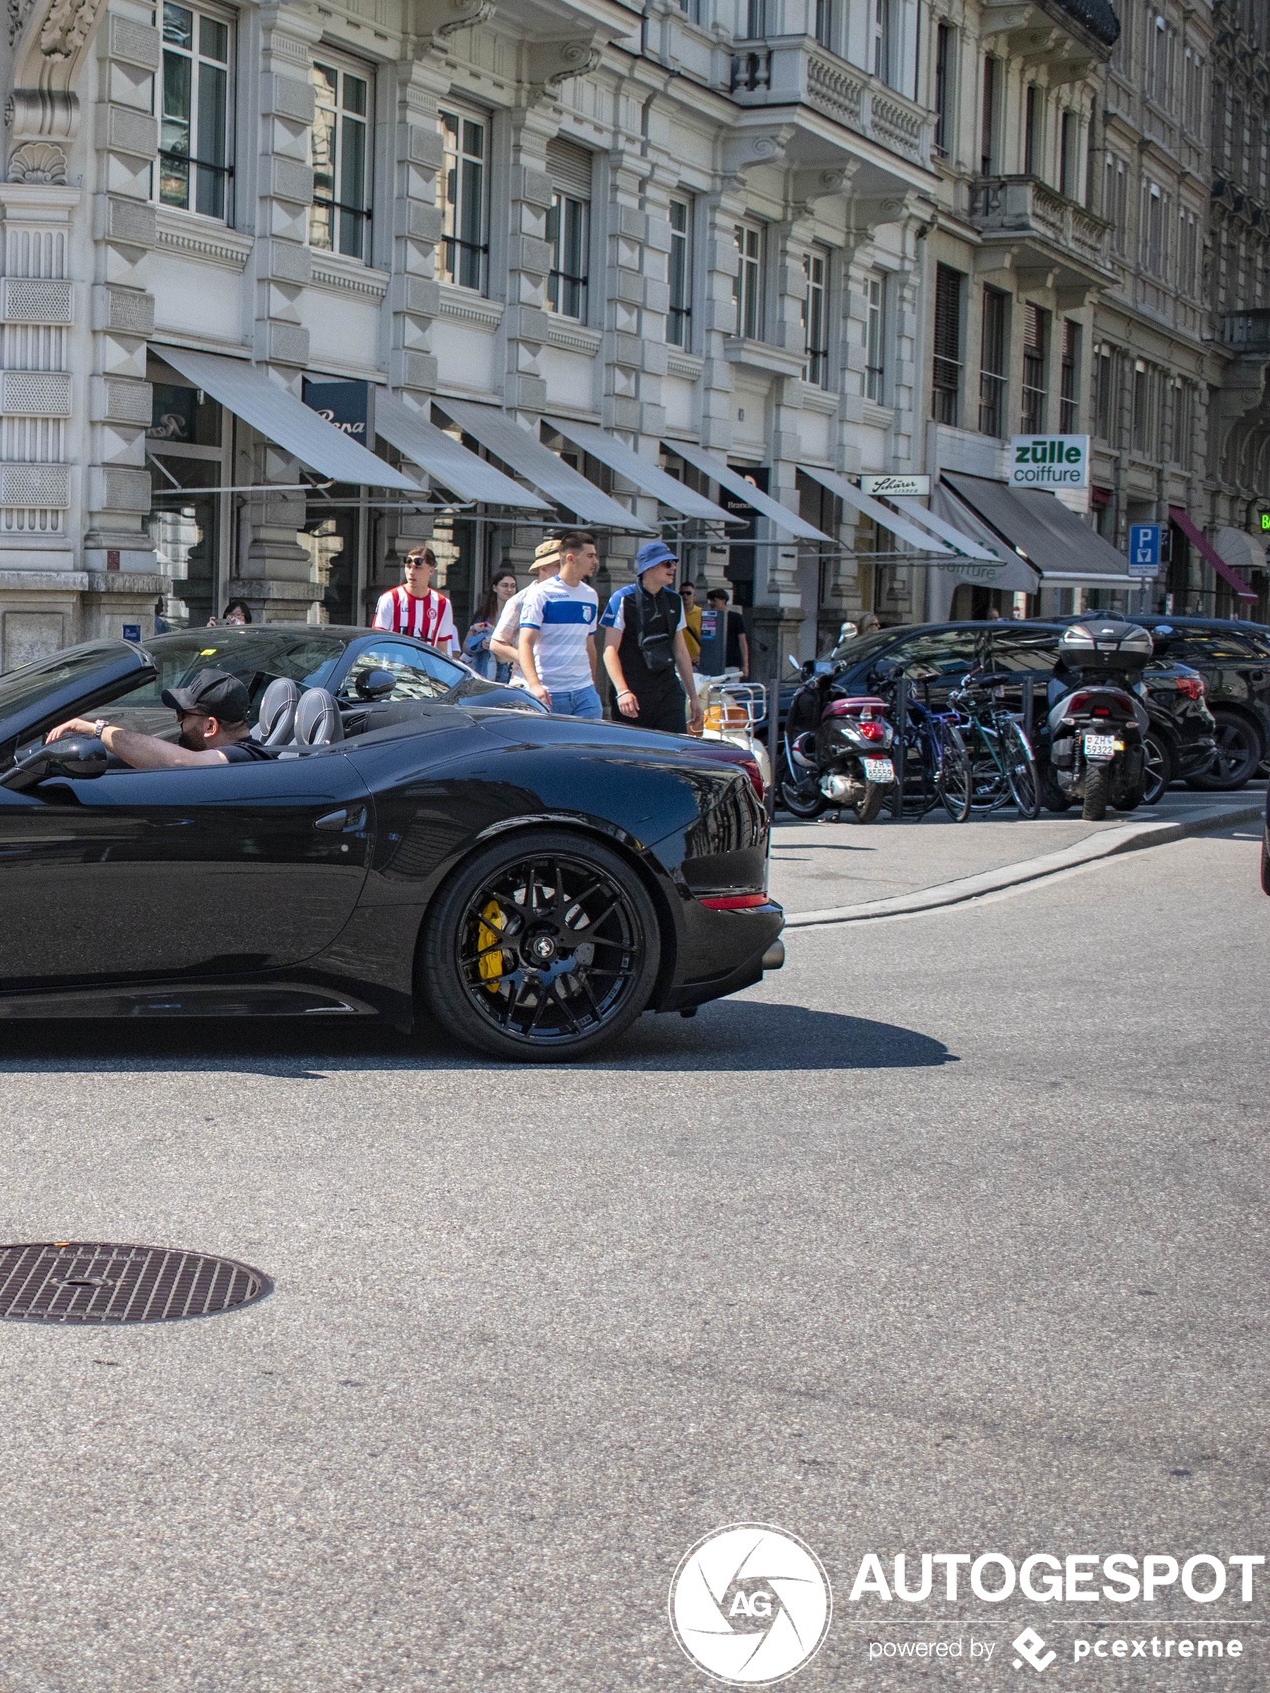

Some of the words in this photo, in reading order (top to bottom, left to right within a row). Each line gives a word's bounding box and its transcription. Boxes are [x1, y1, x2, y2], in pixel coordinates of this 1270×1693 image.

[1014, 465, 1081, 482] coiffure
[1139, 529, 1152, 547] P
[1086, 745, 1113, 754] 59322
